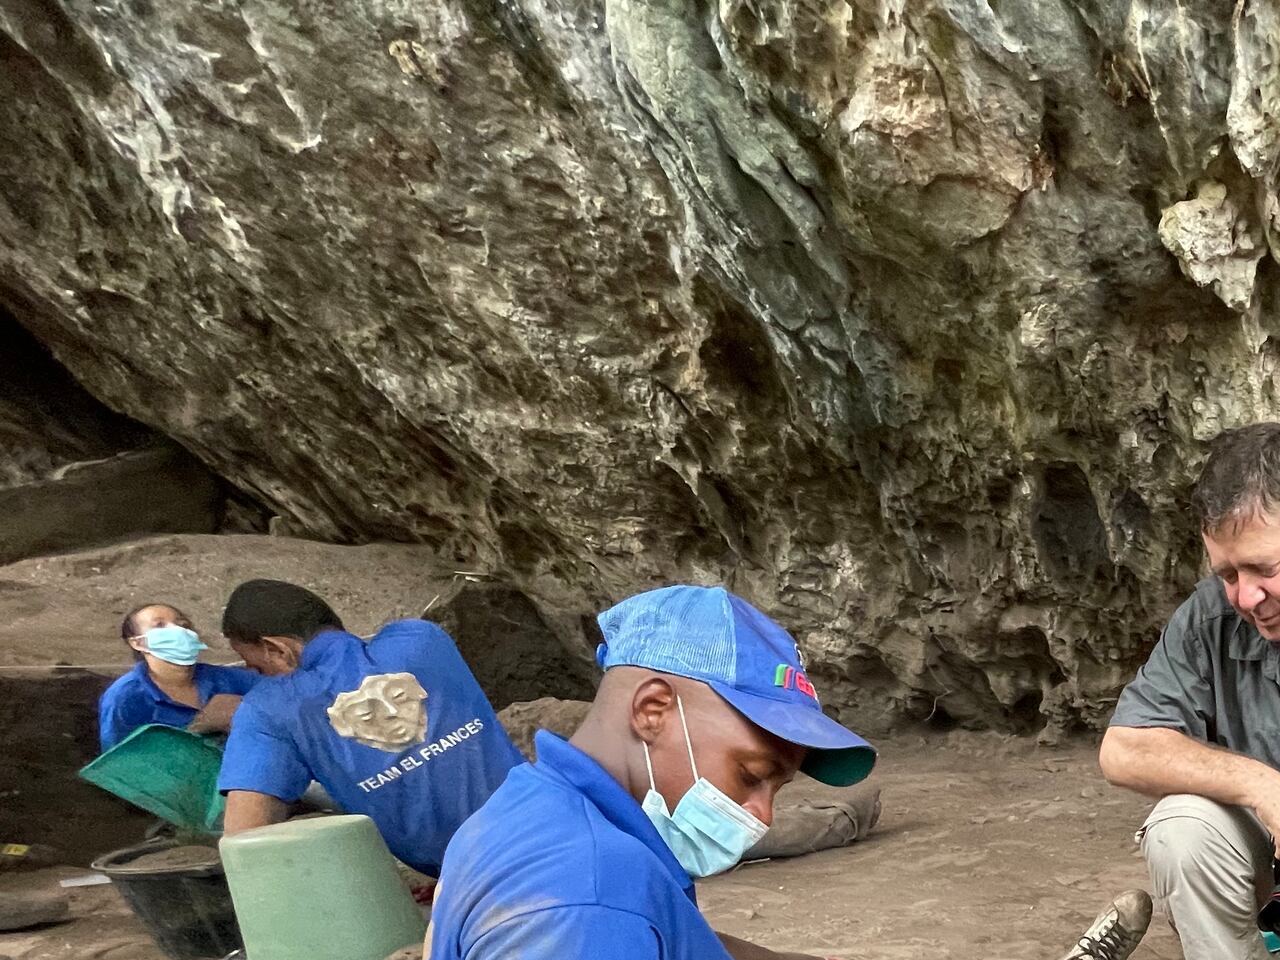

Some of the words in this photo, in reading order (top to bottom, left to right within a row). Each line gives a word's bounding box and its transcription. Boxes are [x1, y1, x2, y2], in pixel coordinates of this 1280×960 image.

[357, 766, 402, 793] TEAM
[399, 756, 423, 772] EL
[420, 718, 484, 761] FRANCES
